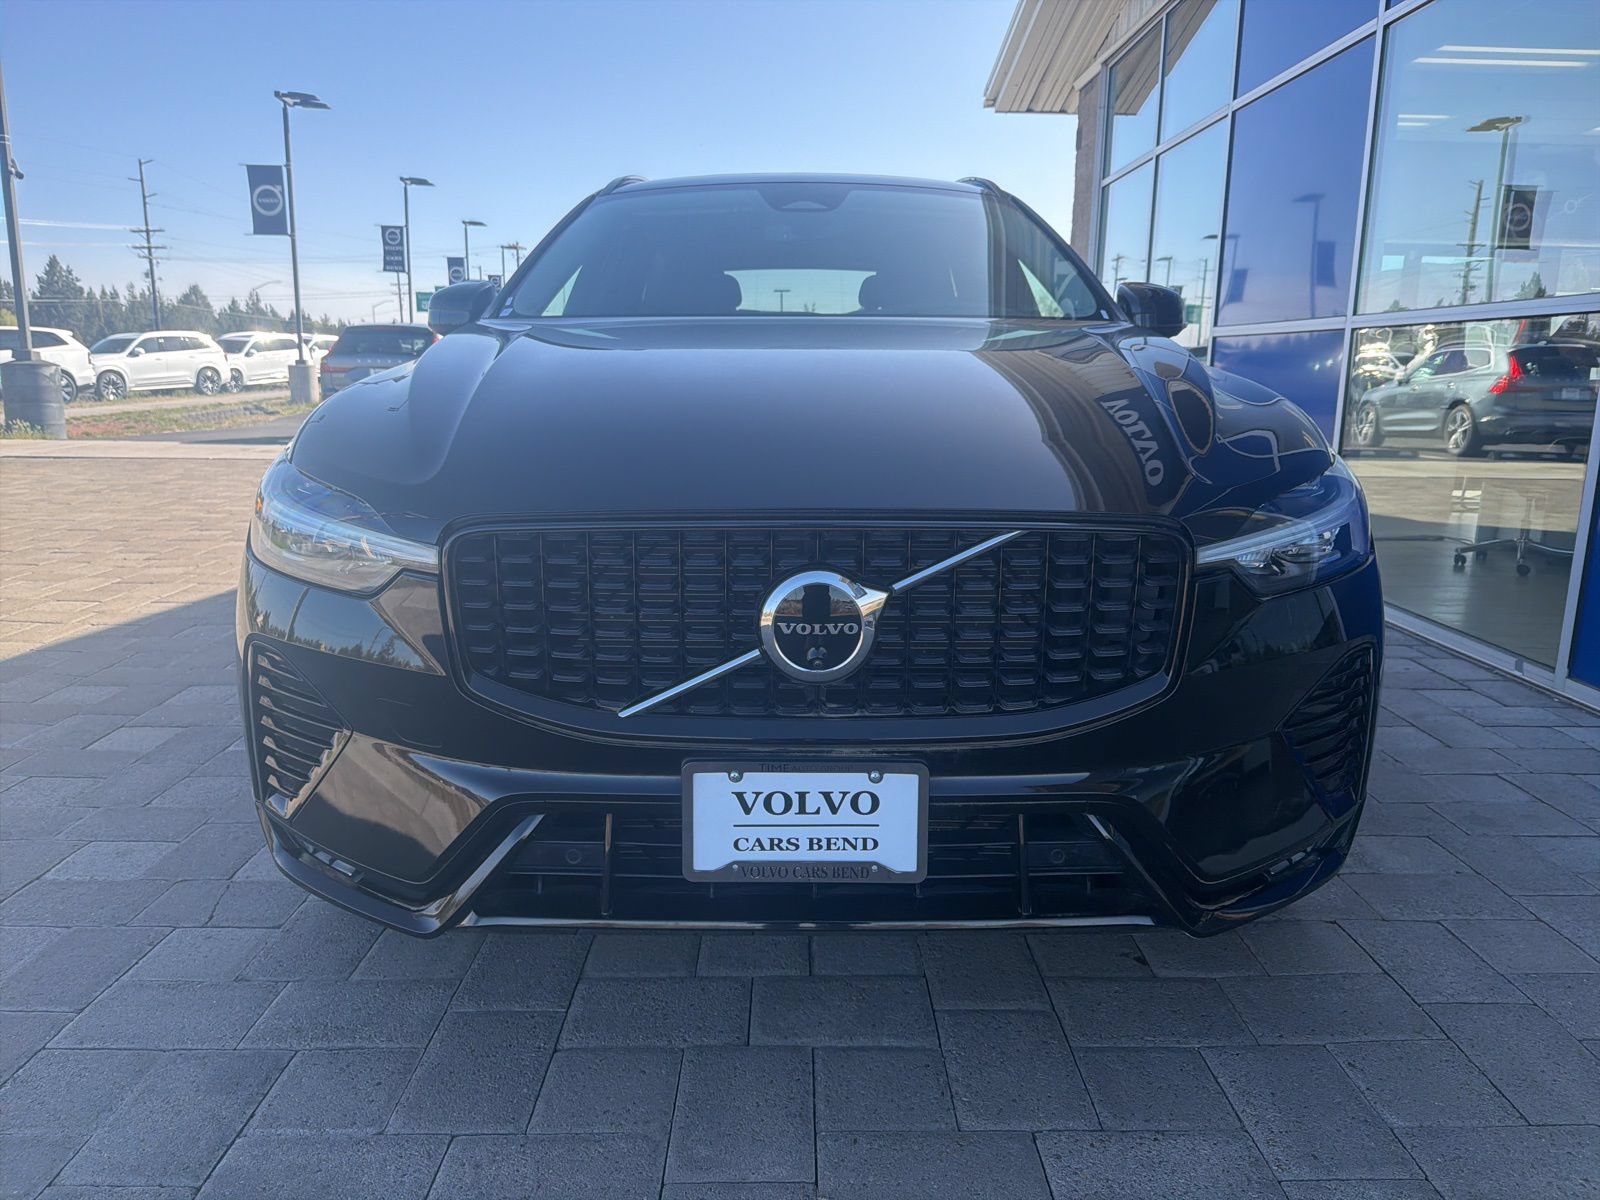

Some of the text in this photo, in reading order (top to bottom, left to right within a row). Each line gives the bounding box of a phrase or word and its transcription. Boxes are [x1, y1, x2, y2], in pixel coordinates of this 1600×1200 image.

[777, 622, 859, 635] VOLVO
[731, 791, 880, 815] VOLVO
[733, 837, 879, 852] CARS BEND
[741, 866, 870, 879] VOLVO CARS BEND
